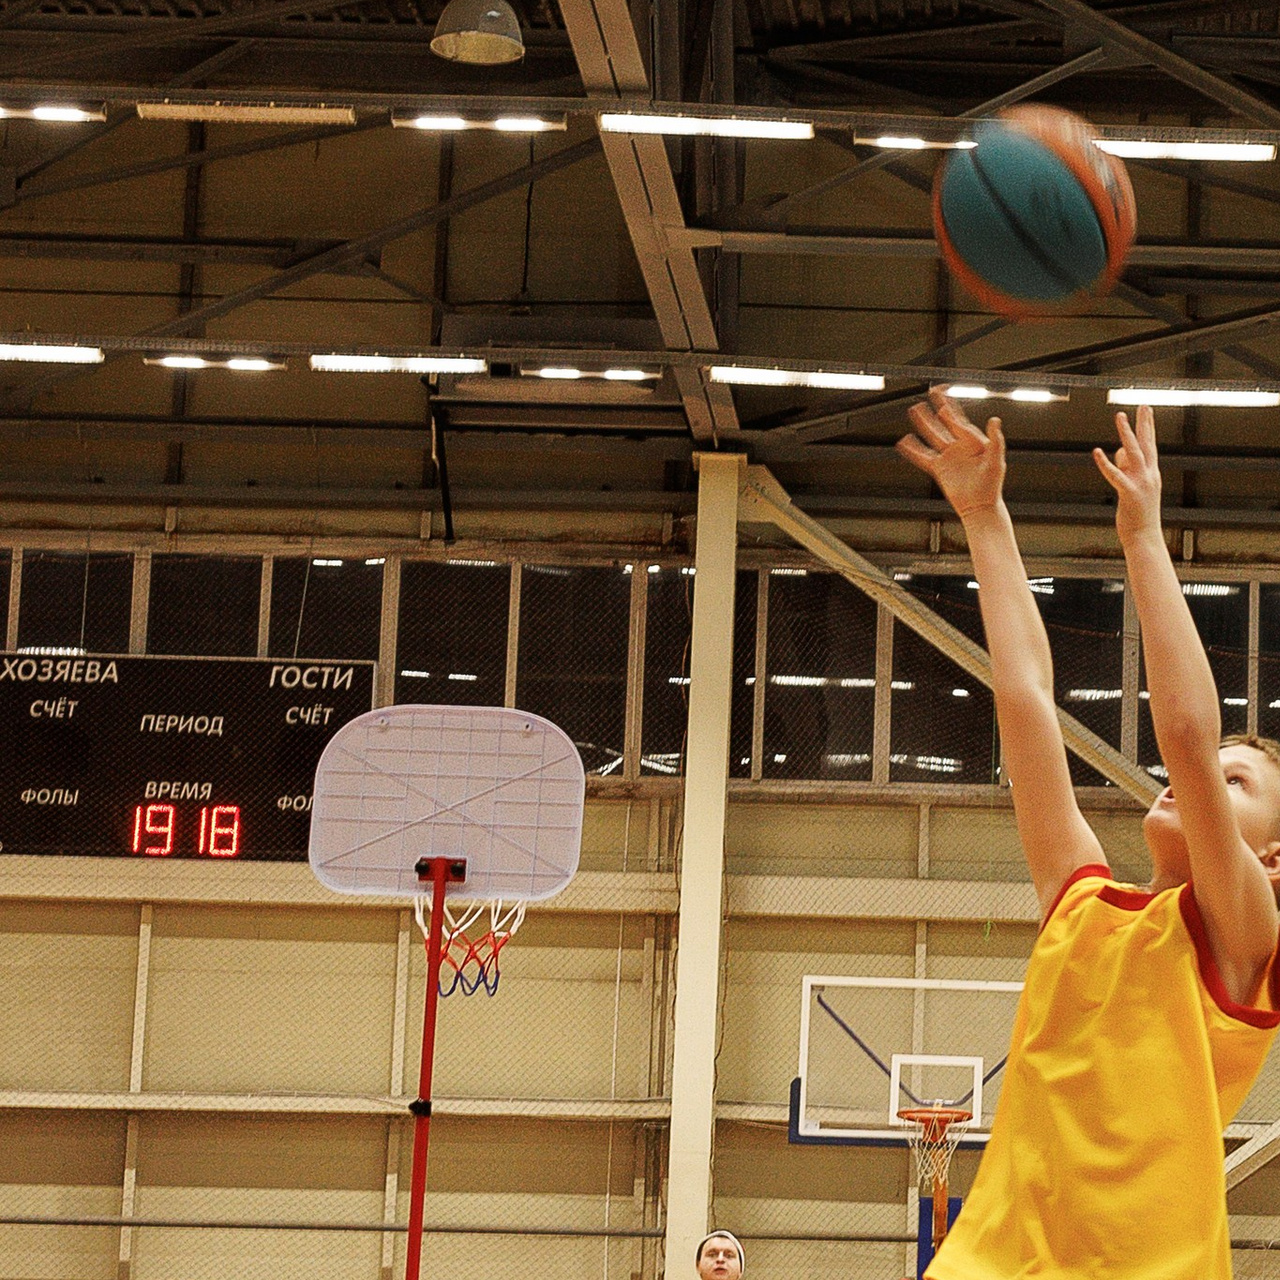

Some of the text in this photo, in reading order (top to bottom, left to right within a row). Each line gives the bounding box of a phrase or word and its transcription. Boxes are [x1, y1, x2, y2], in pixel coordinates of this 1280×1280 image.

[1, 658, 119, 684] ХОЗЯЕВА
[269, 665, 354, 691] ГОСТИ
[30, 696, 79, 719] СЧЁТ
[285, 704, 334, 726] СЧЁТ
[140, 714, 224, 737] ПЕРИОД
[21, 787, 79, 806] ФОЛЫ
[144, 780, 213, 801] ВРЕМЯ
[277, 794, 314, 813] ФОЛ
